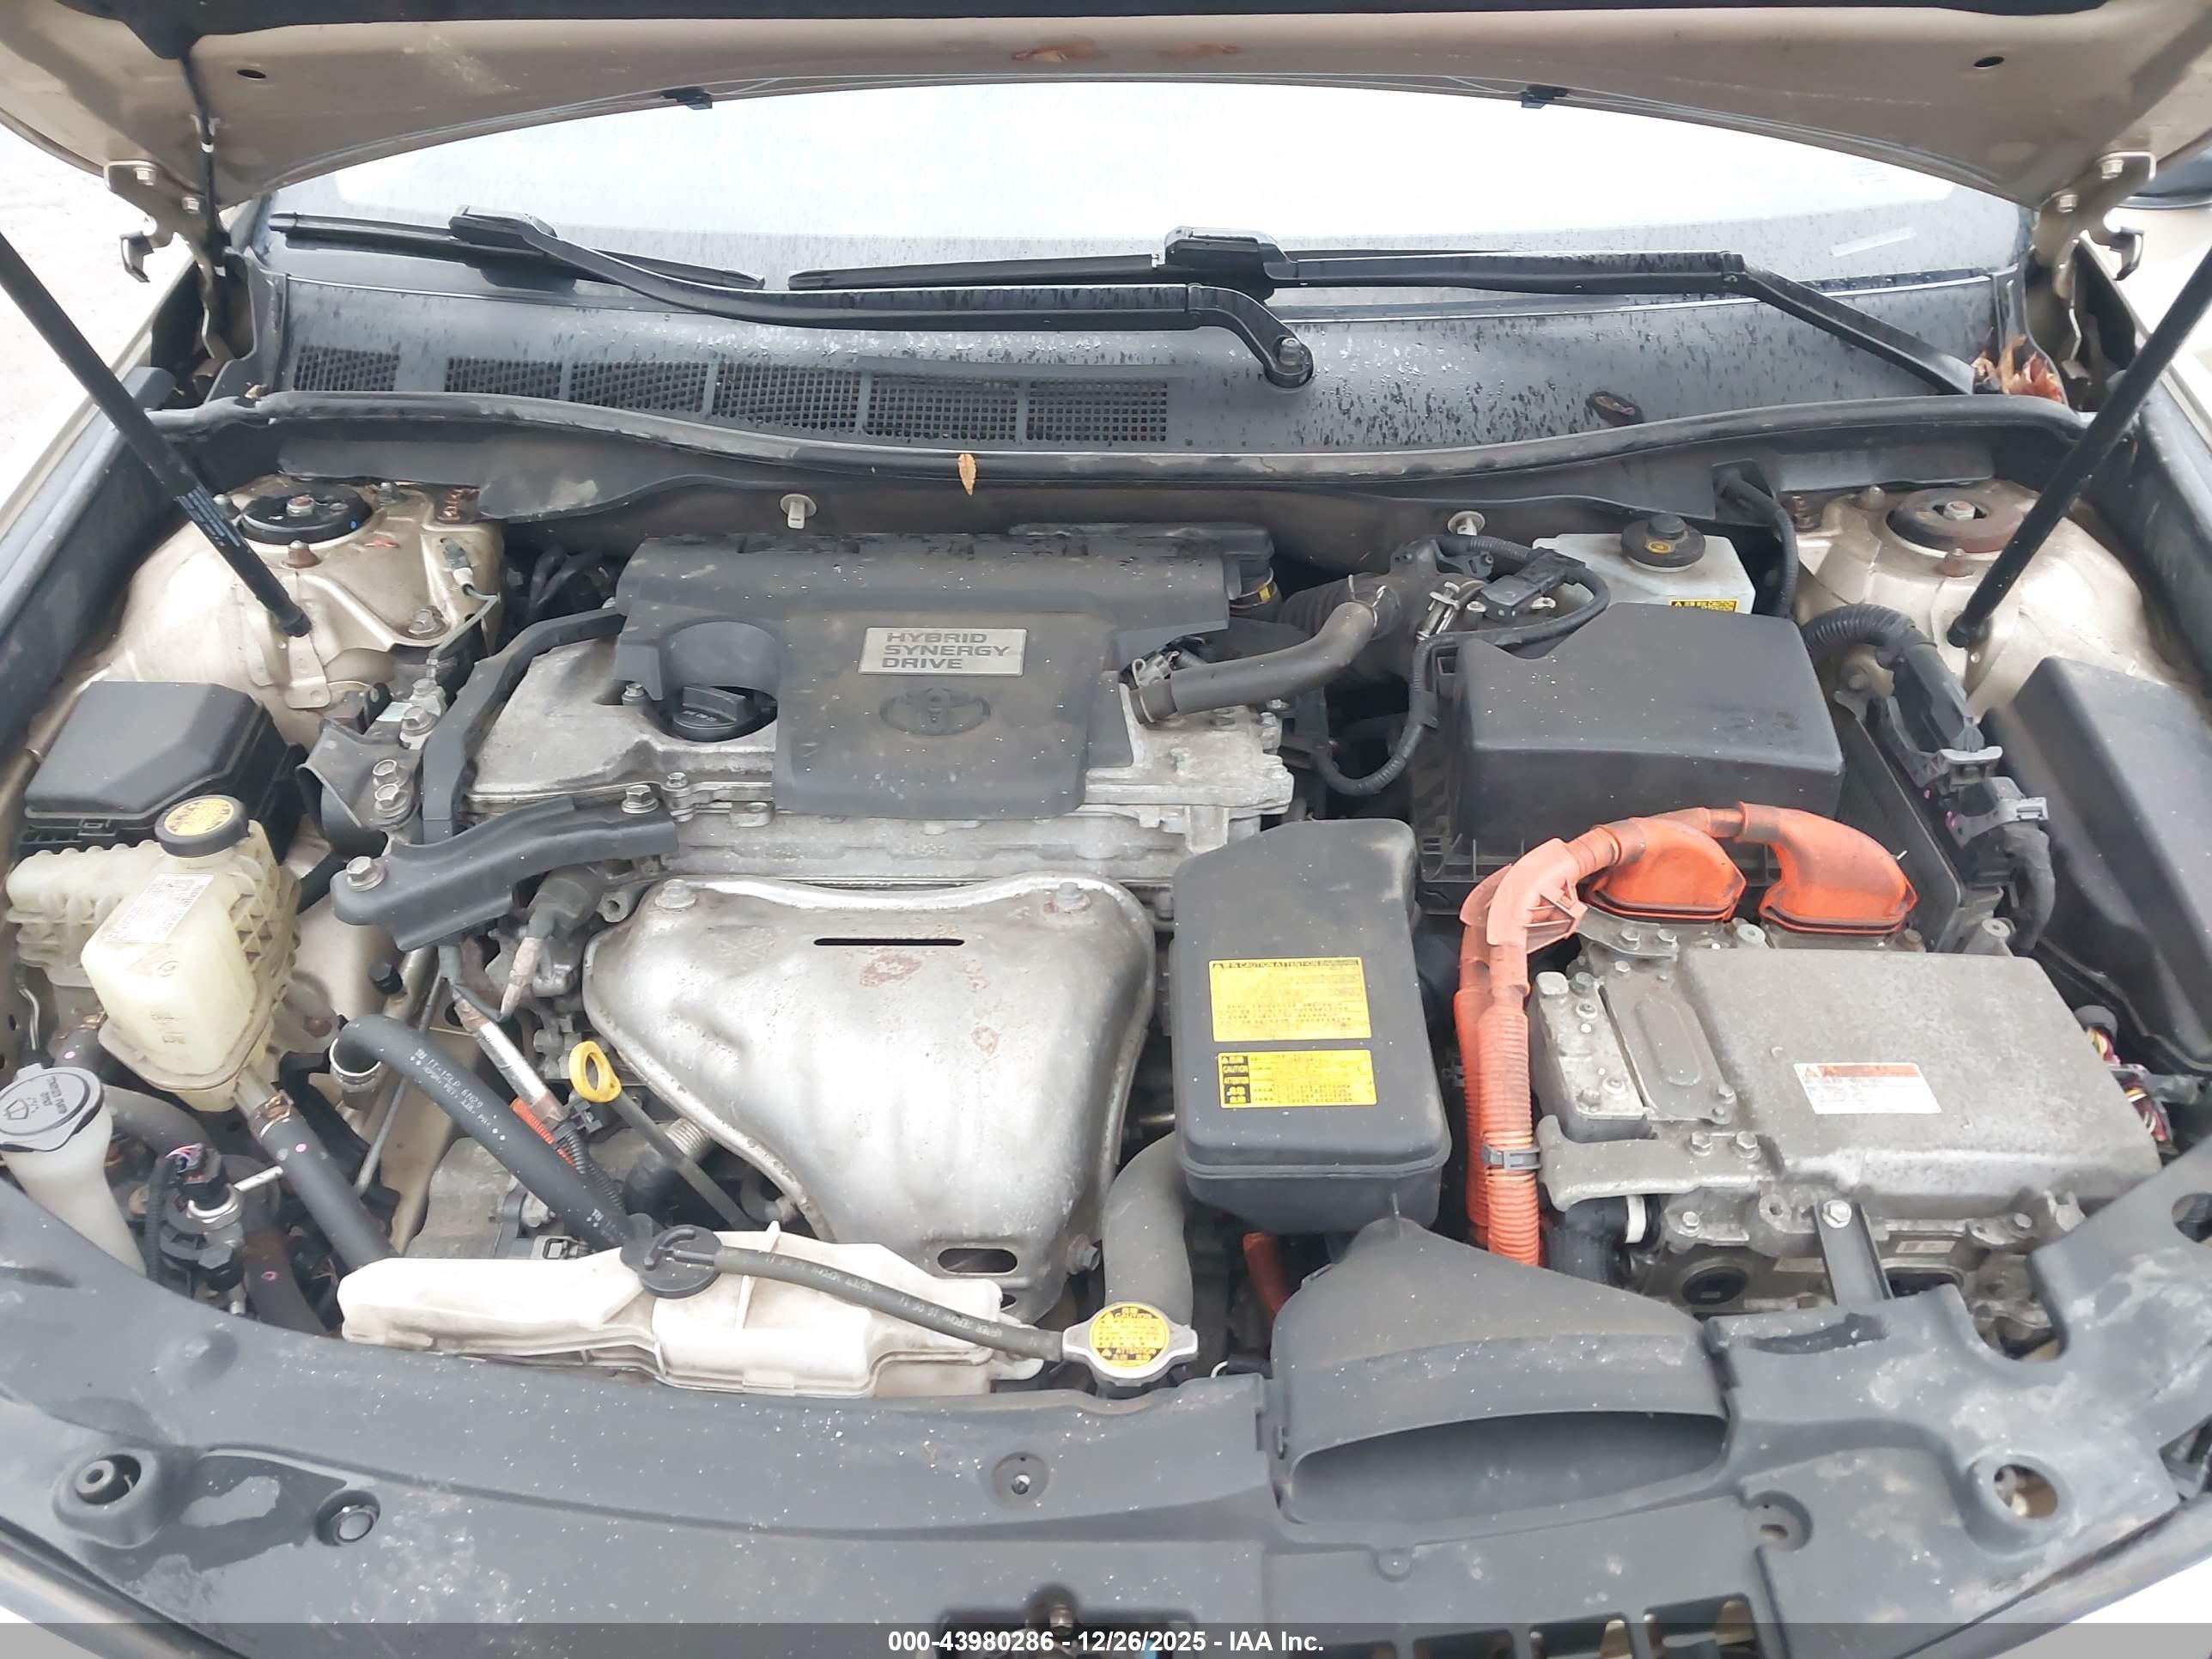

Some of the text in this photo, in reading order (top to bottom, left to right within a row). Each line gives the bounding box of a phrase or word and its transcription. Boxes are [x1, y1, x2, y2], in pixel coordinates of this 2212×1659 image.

[886, 632, 988, 643] HYBRID
[884, 645, 1010, 656] SYNERGY
[881, 658, 963, 669] DRIVE
